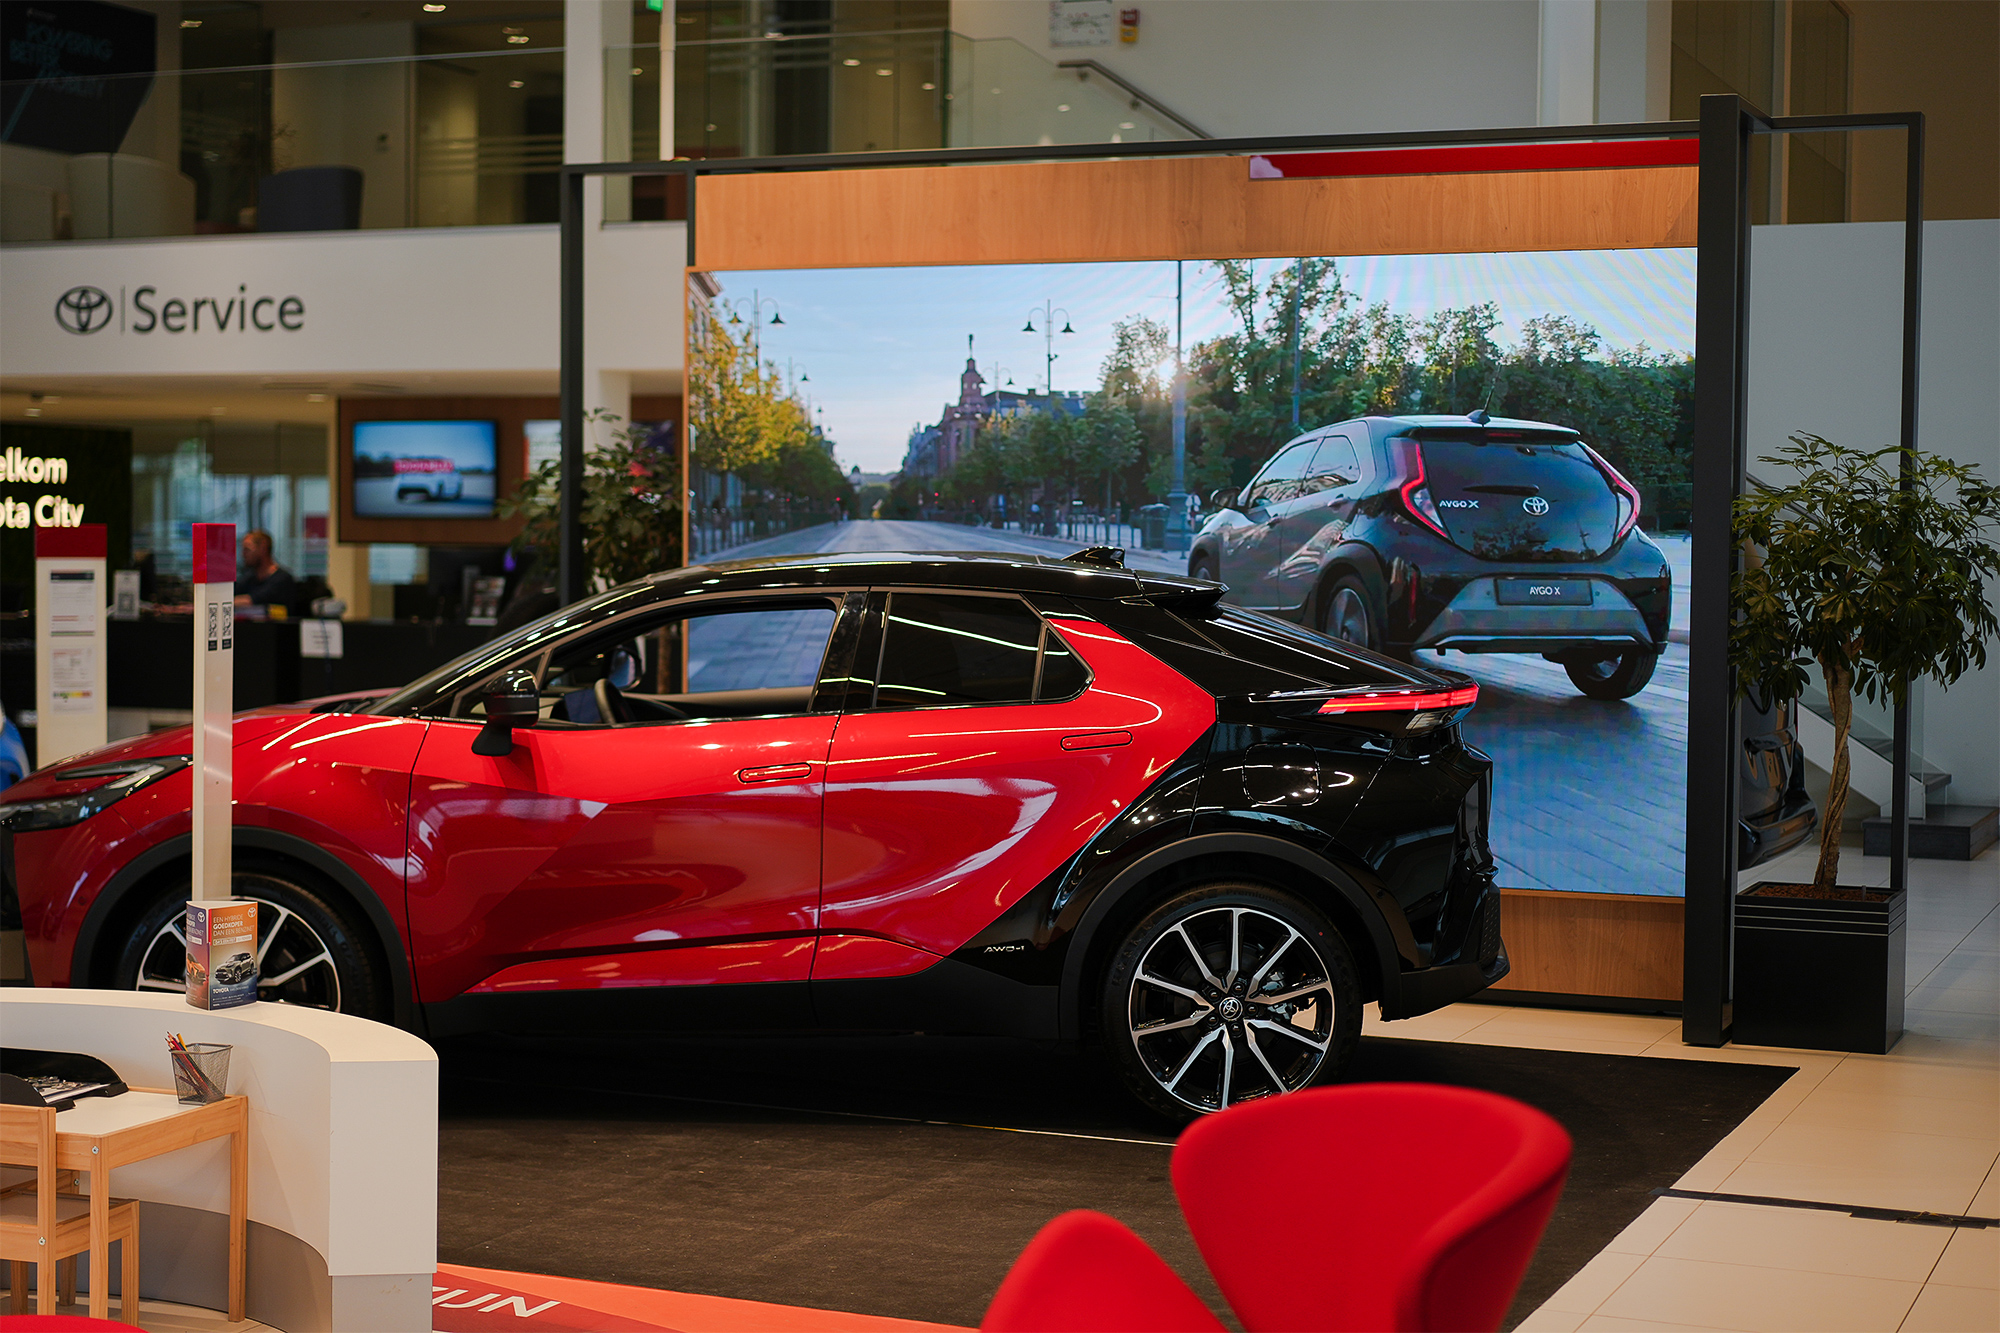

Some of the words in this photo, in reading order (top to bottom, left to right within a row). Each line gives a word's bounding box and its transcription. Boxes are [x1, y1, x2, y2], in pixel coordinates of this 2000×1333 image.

[133, 284, 304, 334] Service
[1439, 500, 1467, 508] AYGO
[1468, 500, 1480, 509] X
[1529, 586, 1553, 595] AYGO
[1554, 586, 1561, 595] X
[213, 920, 243, 930] GOEDKOPER
[432, 1286, 562, 1318] IJN
